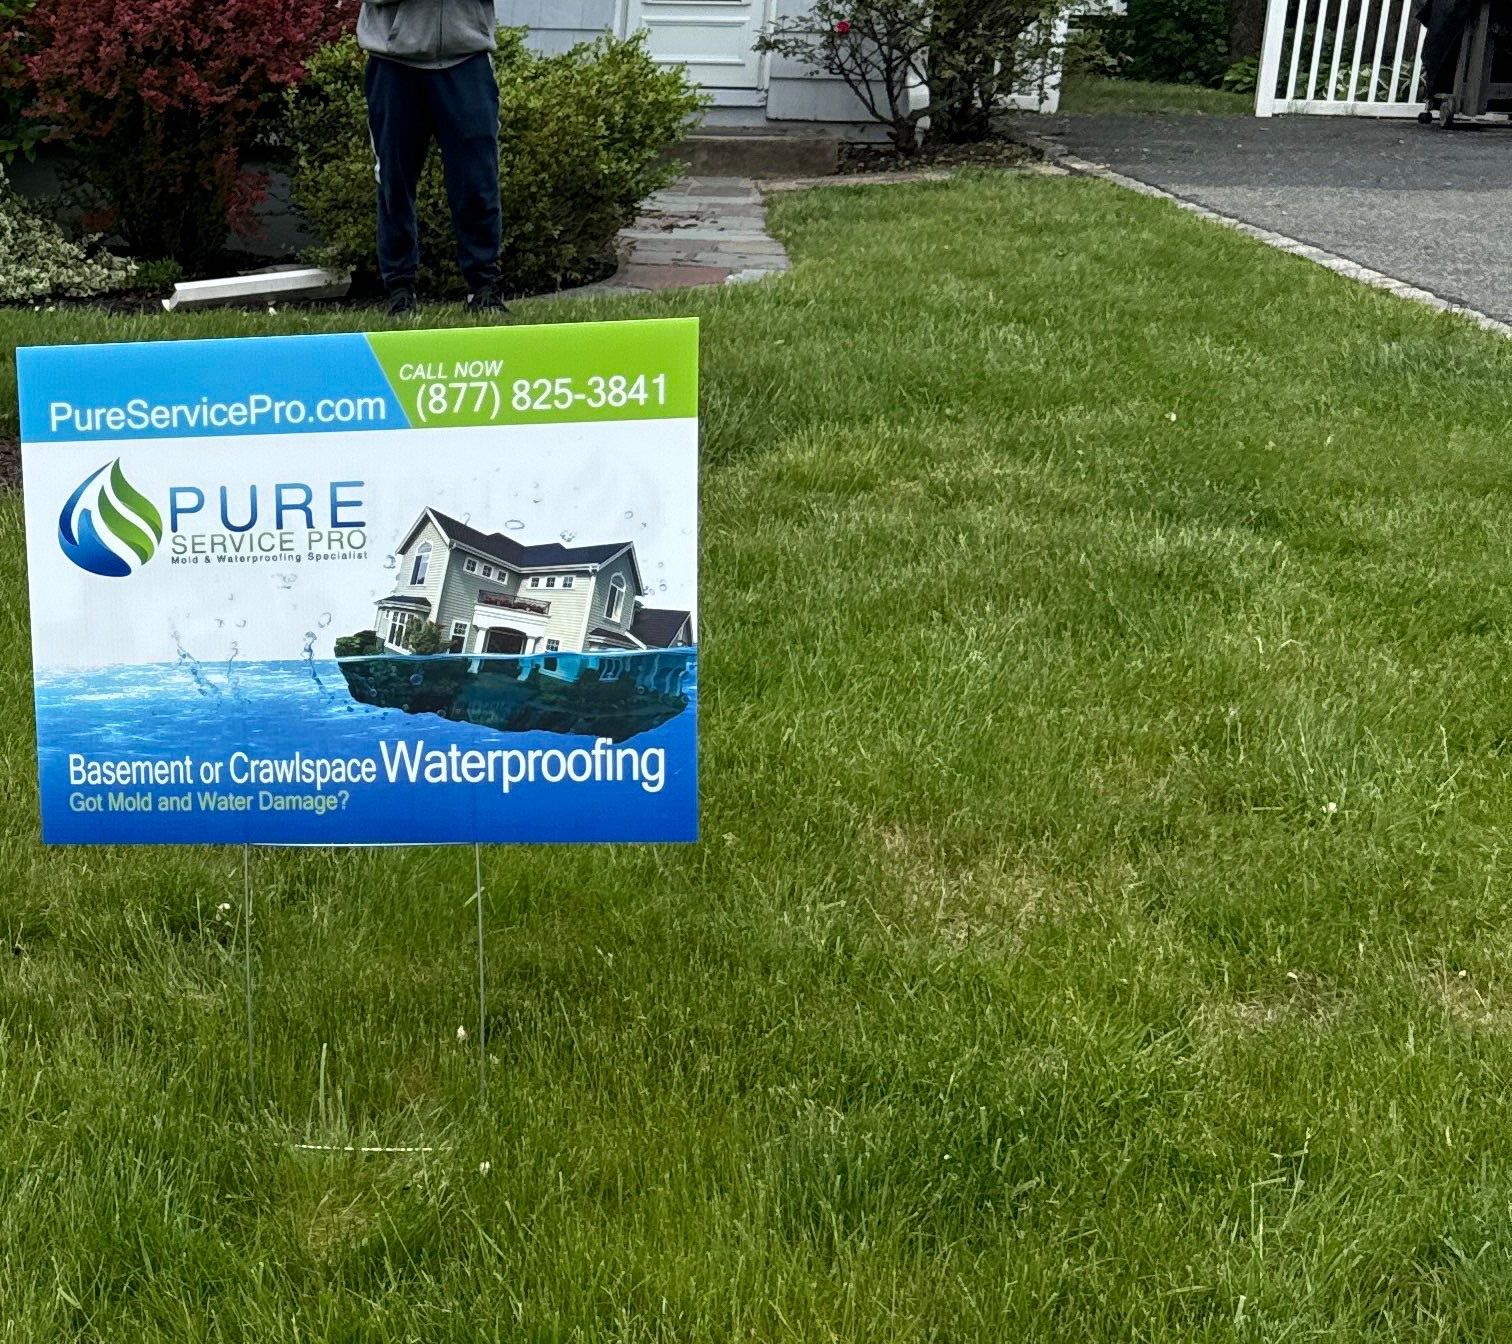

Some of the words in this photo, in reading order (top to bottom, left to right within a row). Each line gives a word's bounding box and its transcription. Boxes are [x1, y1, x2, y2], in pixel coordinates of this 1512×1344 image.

[399, 363, 446, 381] CALL
[454, 360, 504, 377] NOW
[50, 394, 386, 432] PureServicePro.com
[416, 381, 500, 422] (877)
[511, 373, 665, 411] 825-3841
[169, 481, 366, 533] PURE
[171, 532, 295, 554] SERVICE
[308, 530, 367, 551] PRO
[171, 555, 199, 565] Mold
[204, 555, 211, 564] &
[217, 553, 302, 563] Waterproofing
[308, 551, 368, 561] Specialist
[68, 753, 193, 785] Basement
[200, 759, 224, 784] or
[229, 751, 377, 791] Crawlspace
[379, 737, 666, 793] Waterproofing
[69, 792, 104, 813] Got
[108, 791, 152, 812] Mold
[158, 791, 193, 812] and
[197, 791, 253, 812] Water
[259, 789, 350, 816] Damage?
